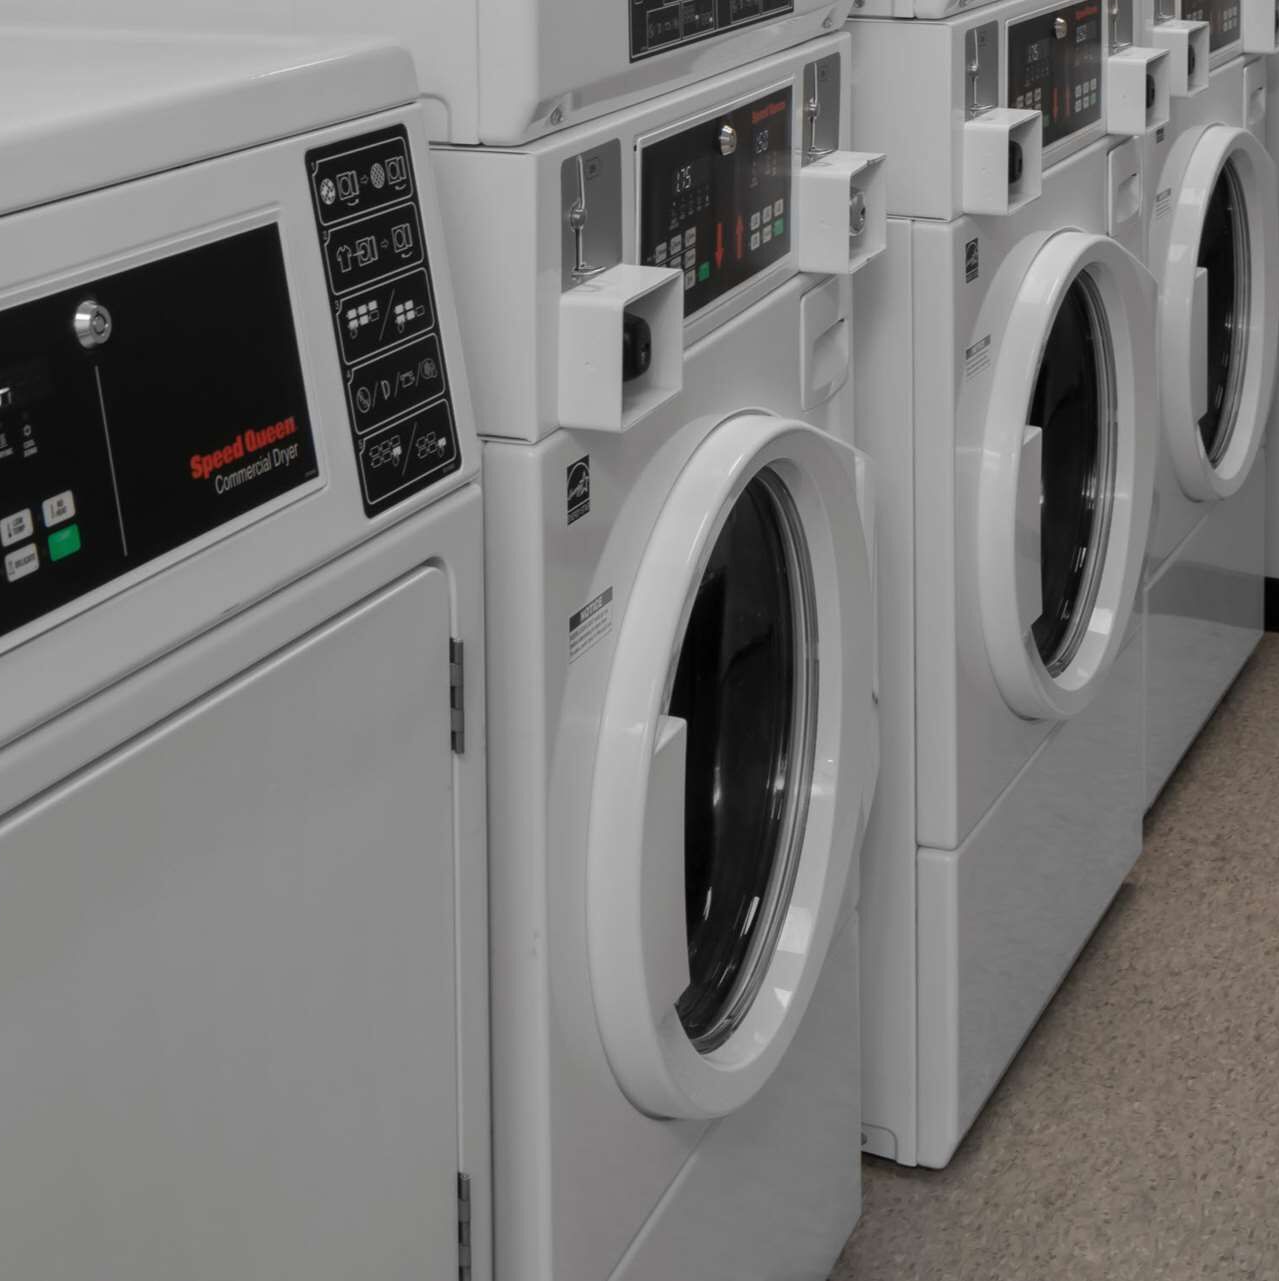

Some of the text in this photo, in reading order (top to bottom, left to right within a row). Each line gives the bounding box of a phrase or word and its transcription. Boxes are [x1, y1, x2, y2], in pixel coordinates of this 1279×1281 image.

[190, 416, 297, 479] Speed Queen
[215, 443, 300, 495] Commercial Dryer
